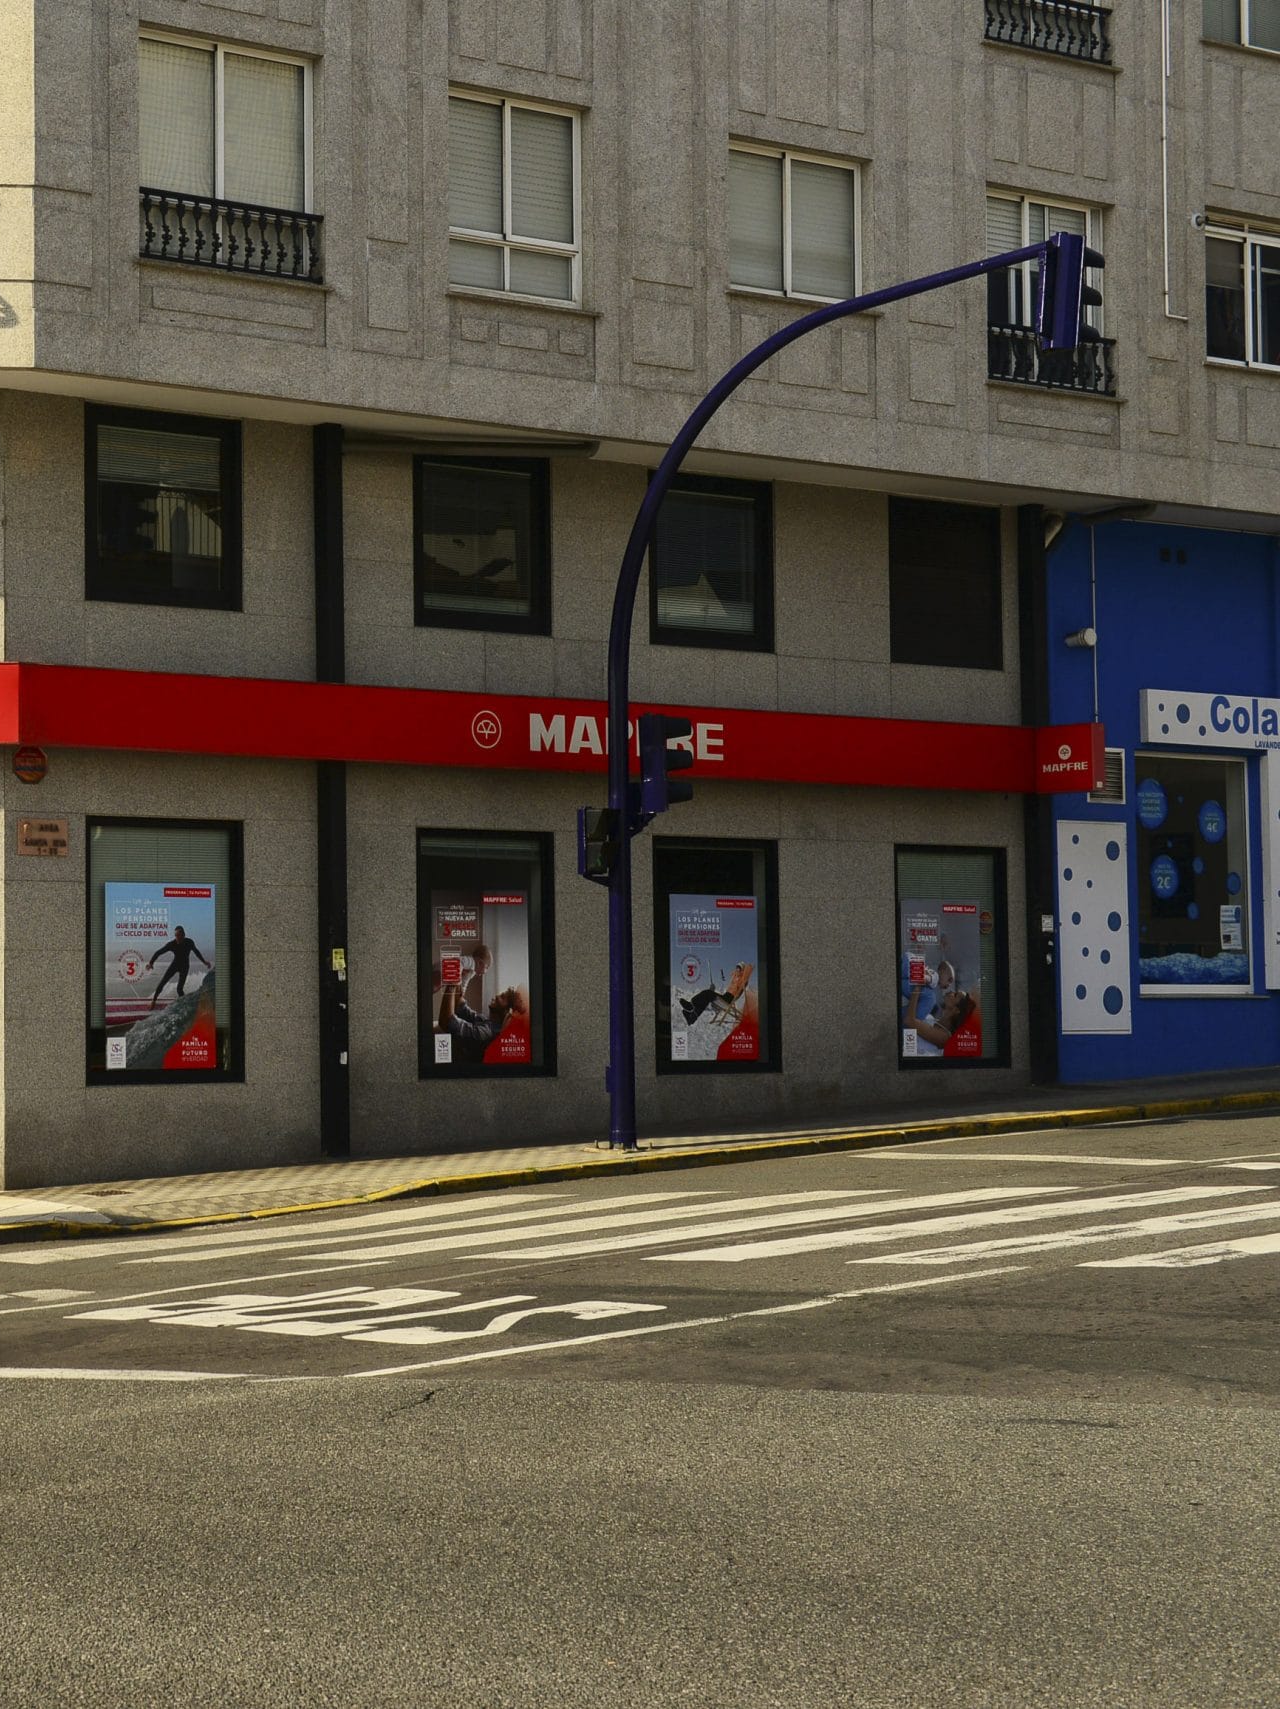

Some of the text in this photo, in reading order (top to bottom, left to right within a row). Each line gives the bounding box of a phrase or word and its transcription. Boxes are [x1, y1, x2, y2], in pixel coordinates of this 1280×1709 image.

[1210, 695, 1278, 736] Cola
[1042, 761, 1088, 773] MAPFRE
[1206, 822, 1218, 833] 4€
[1157, 876, 1170, 888] 2€
[443, 922, 451, 936] 3
[127, 962, 135, 976] 3
[688, 965, 694, 977] 3
